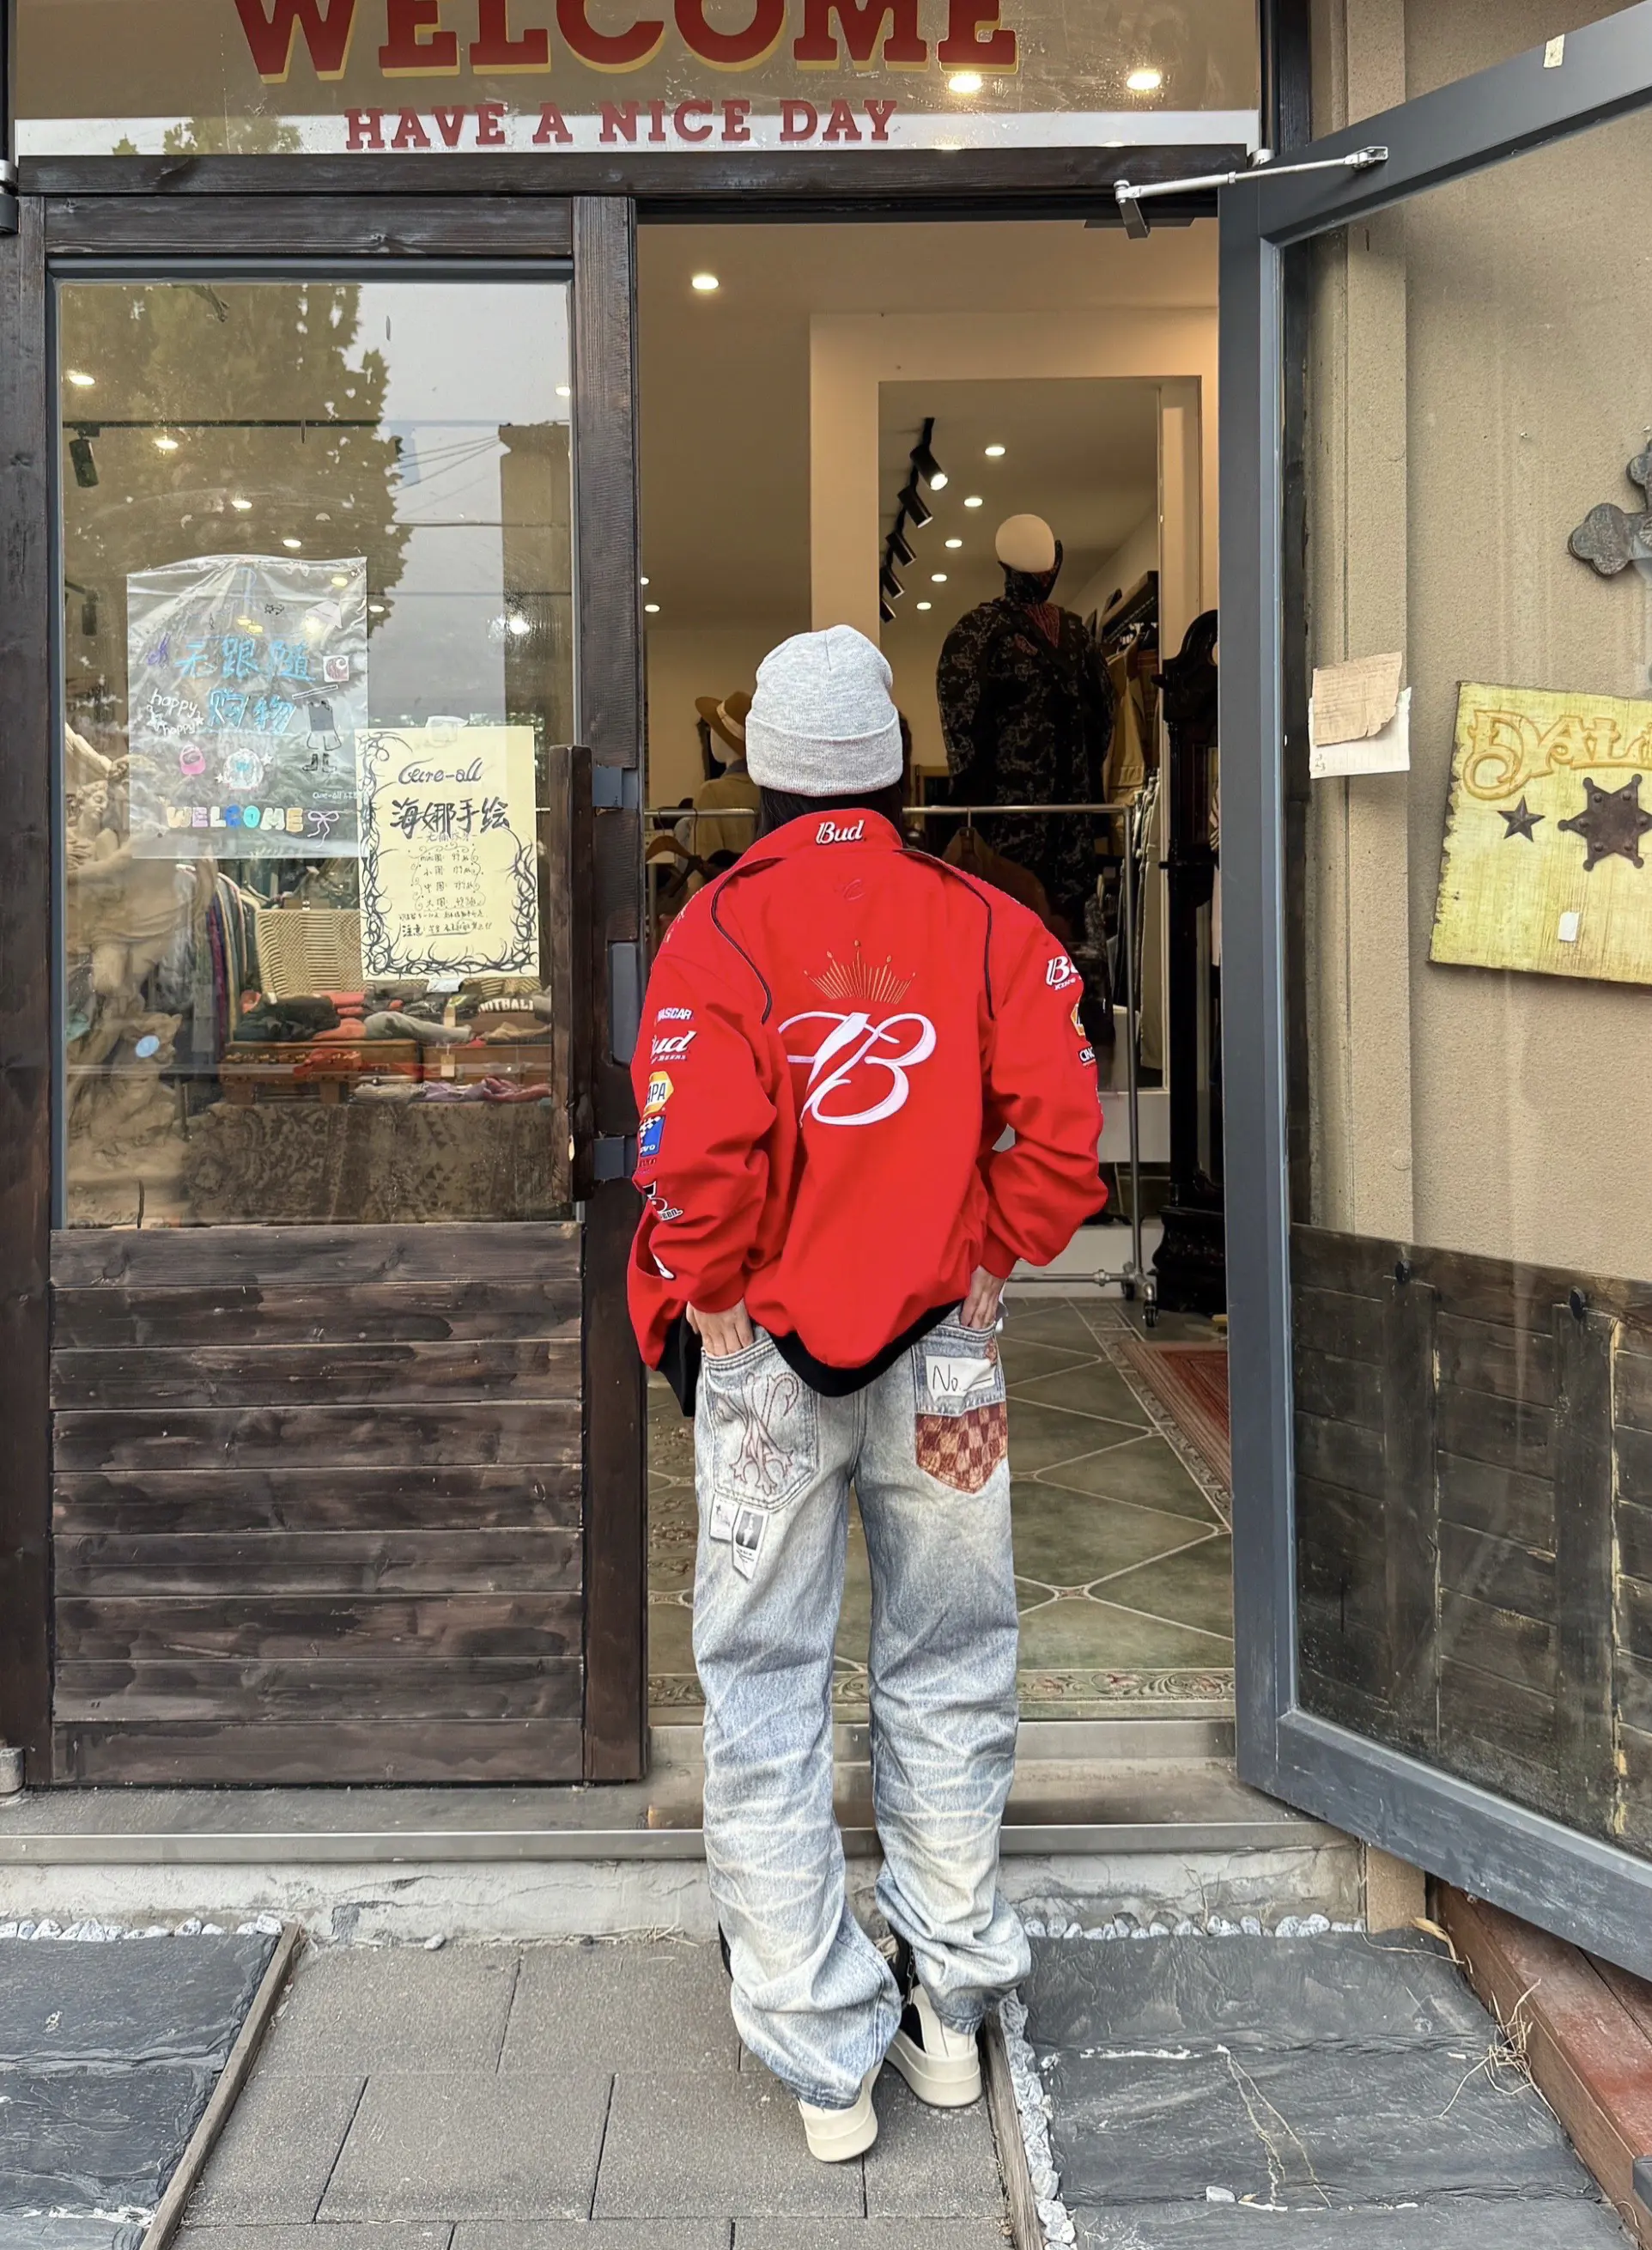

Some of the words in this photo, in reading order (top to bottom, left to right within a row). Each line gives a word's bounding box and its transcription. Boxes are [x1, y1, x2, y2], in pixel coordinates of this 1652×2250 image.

[235, 0, 1019, 83] WELCOME
[344, 104, 510, 149] HAVE
[532, 102, 573, 144] A
[599, 100, 750, 143] NICE
[780, 100, 897, 143] DAY
[150, 687, 198, 719] happy
[209, 690, 296, 733] 购物
[167, 804, 304, 833] WELCOME
[390, 797, 510, 839] 海娜手绘
[815, 819, 865, 845] Bud
